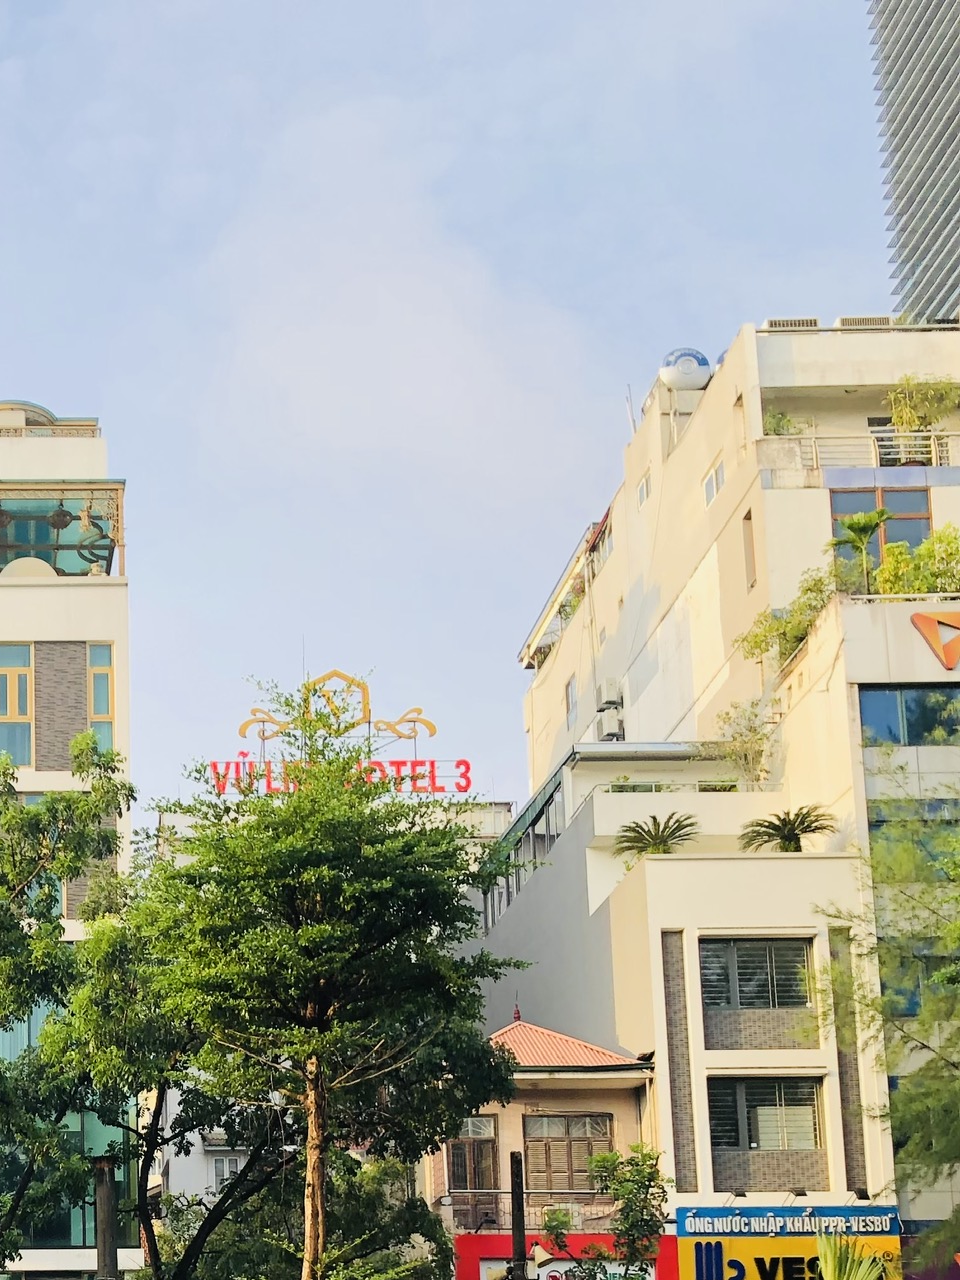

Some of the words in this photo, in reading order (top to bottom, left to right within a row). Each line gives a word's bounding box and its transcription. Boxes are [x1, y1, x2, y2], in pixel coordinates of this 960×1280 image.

[453, 758, 472, 793] 3
[685, 1209, 713, 1233] ỐNG
[714, 1210, 749, 1233] NƯỚC
[750, 1212, 785, 1237] NHẬP
[786, 1207, 819, 1233] KHẨU
